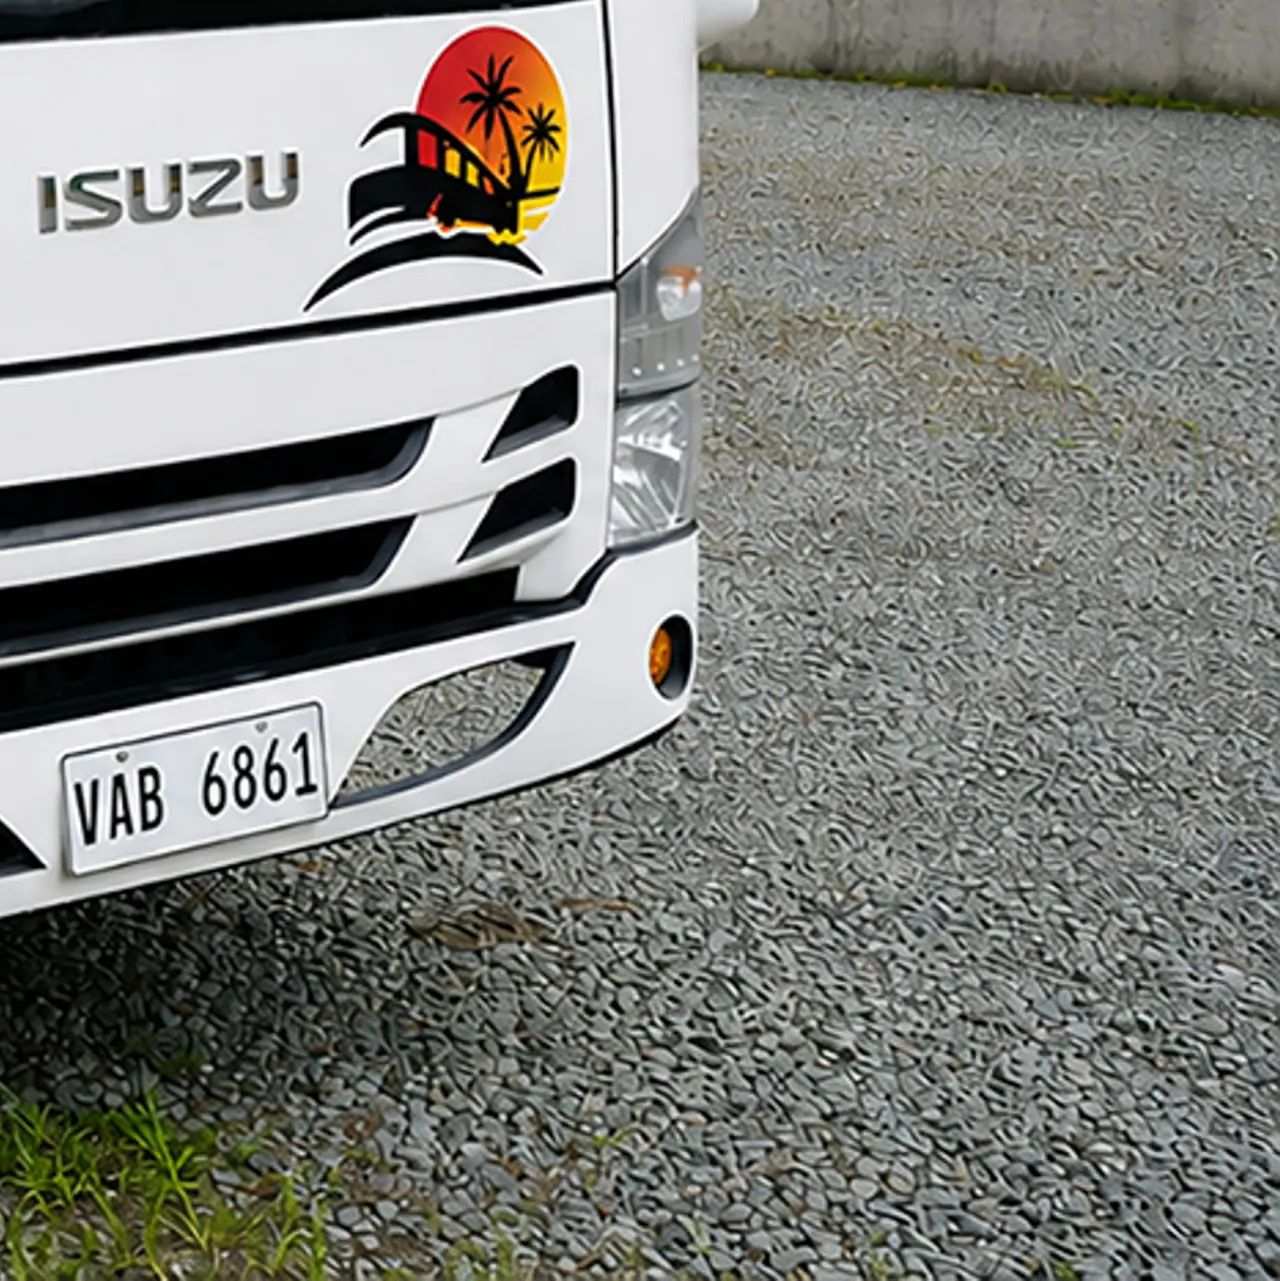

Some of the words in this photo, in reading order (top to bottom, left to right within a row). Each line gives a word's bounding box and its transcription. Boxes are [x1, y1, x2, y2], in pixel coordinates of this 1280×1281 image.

[39, 151, 300, 234] ISUZU
[74, 765, 164, 846] VAB
[202, 732, 318, 816] 6861
